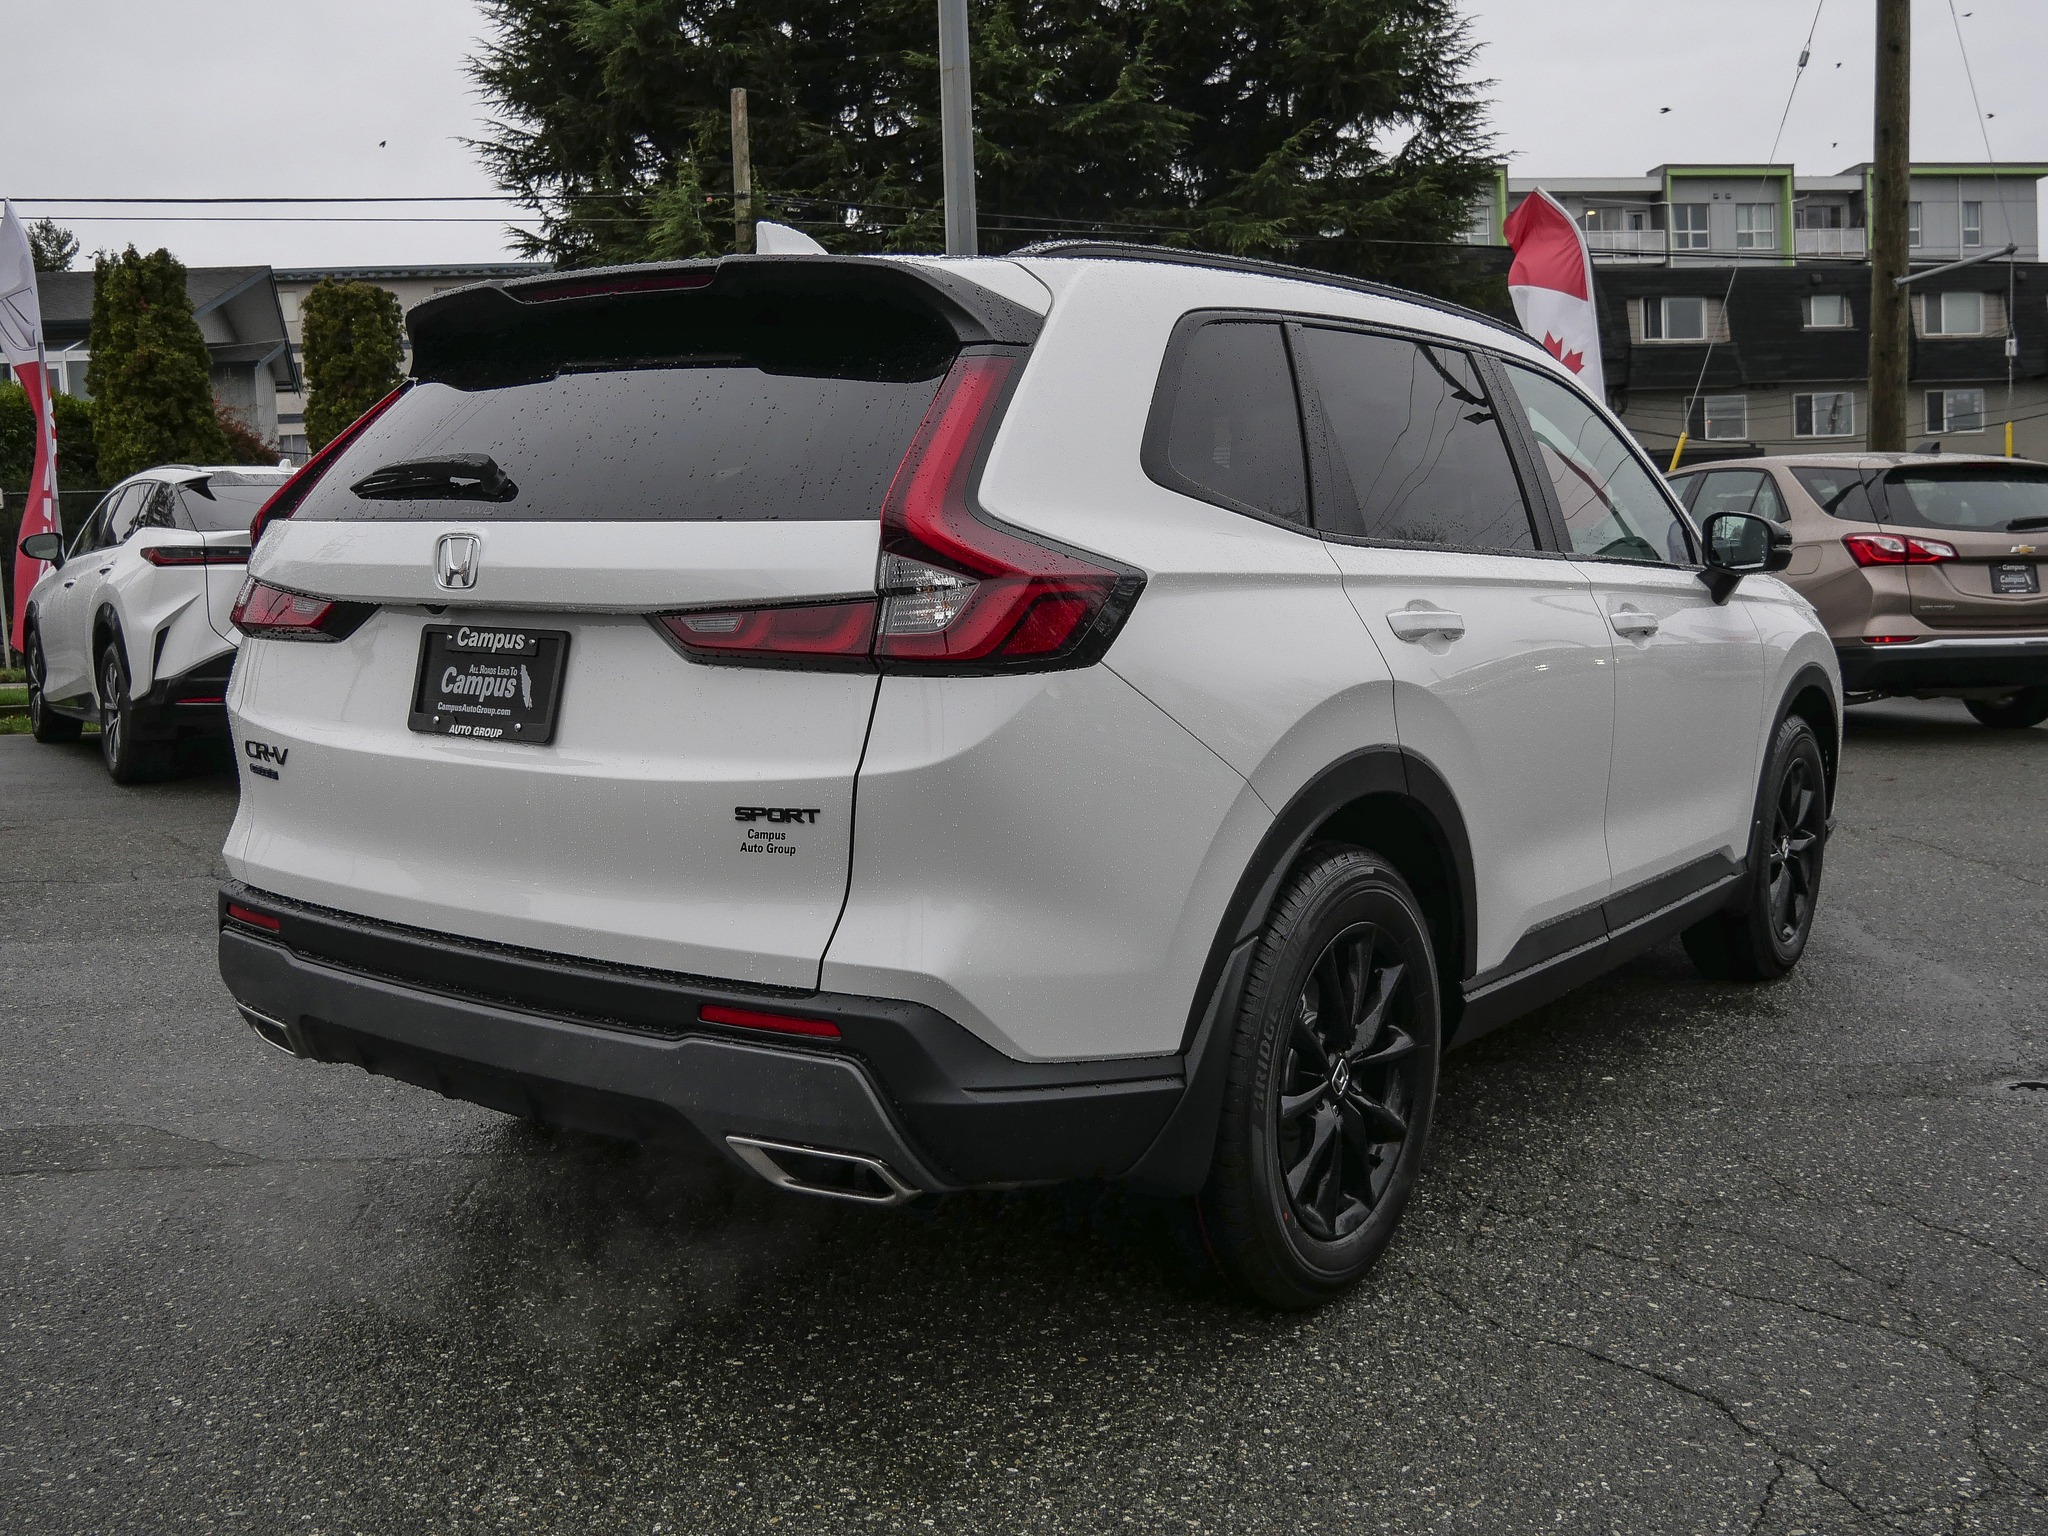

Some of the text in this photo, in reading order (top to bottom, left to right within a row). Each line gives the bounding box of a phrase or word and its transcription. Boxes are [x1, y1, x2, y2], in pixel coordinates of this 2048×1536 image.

[460, 506, 495, 514] AWD
[457, 627, 526, 653] Campus
[441, 666, 517, 702] Campus
[437, 701, 511, 717] CampusAutoGroup.com
[448, 724, 503, 738] AUTO GROUP
[245, 740, 289, 766] CR-V
[734, 806, 821, 824] SPORT
[747, 828, 786, 842] Campus
[740, 842, 796, 857] Auto Group
